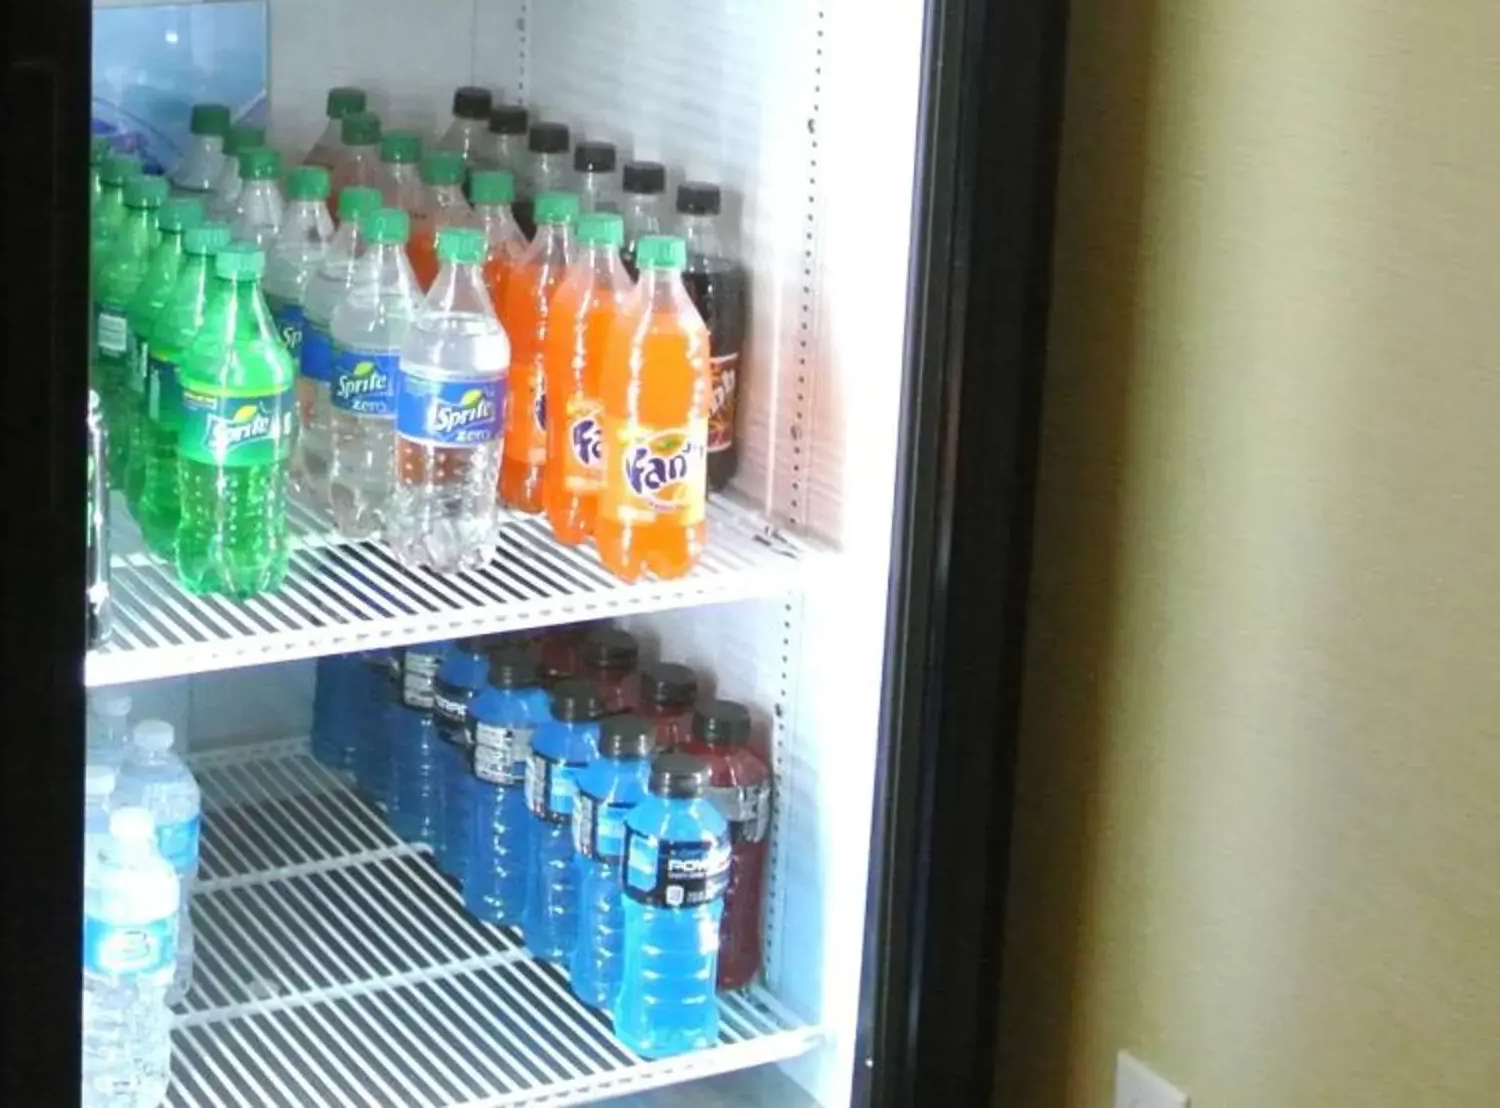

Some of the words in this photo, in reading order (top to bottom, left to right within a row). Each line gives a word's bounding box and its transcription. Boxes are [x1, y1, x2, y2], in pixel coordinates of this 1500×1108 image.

[338, 372, 388, 399] Sprite
[352, 399, 388, 413] zero
[435, 398, 490, 434] Sprite
